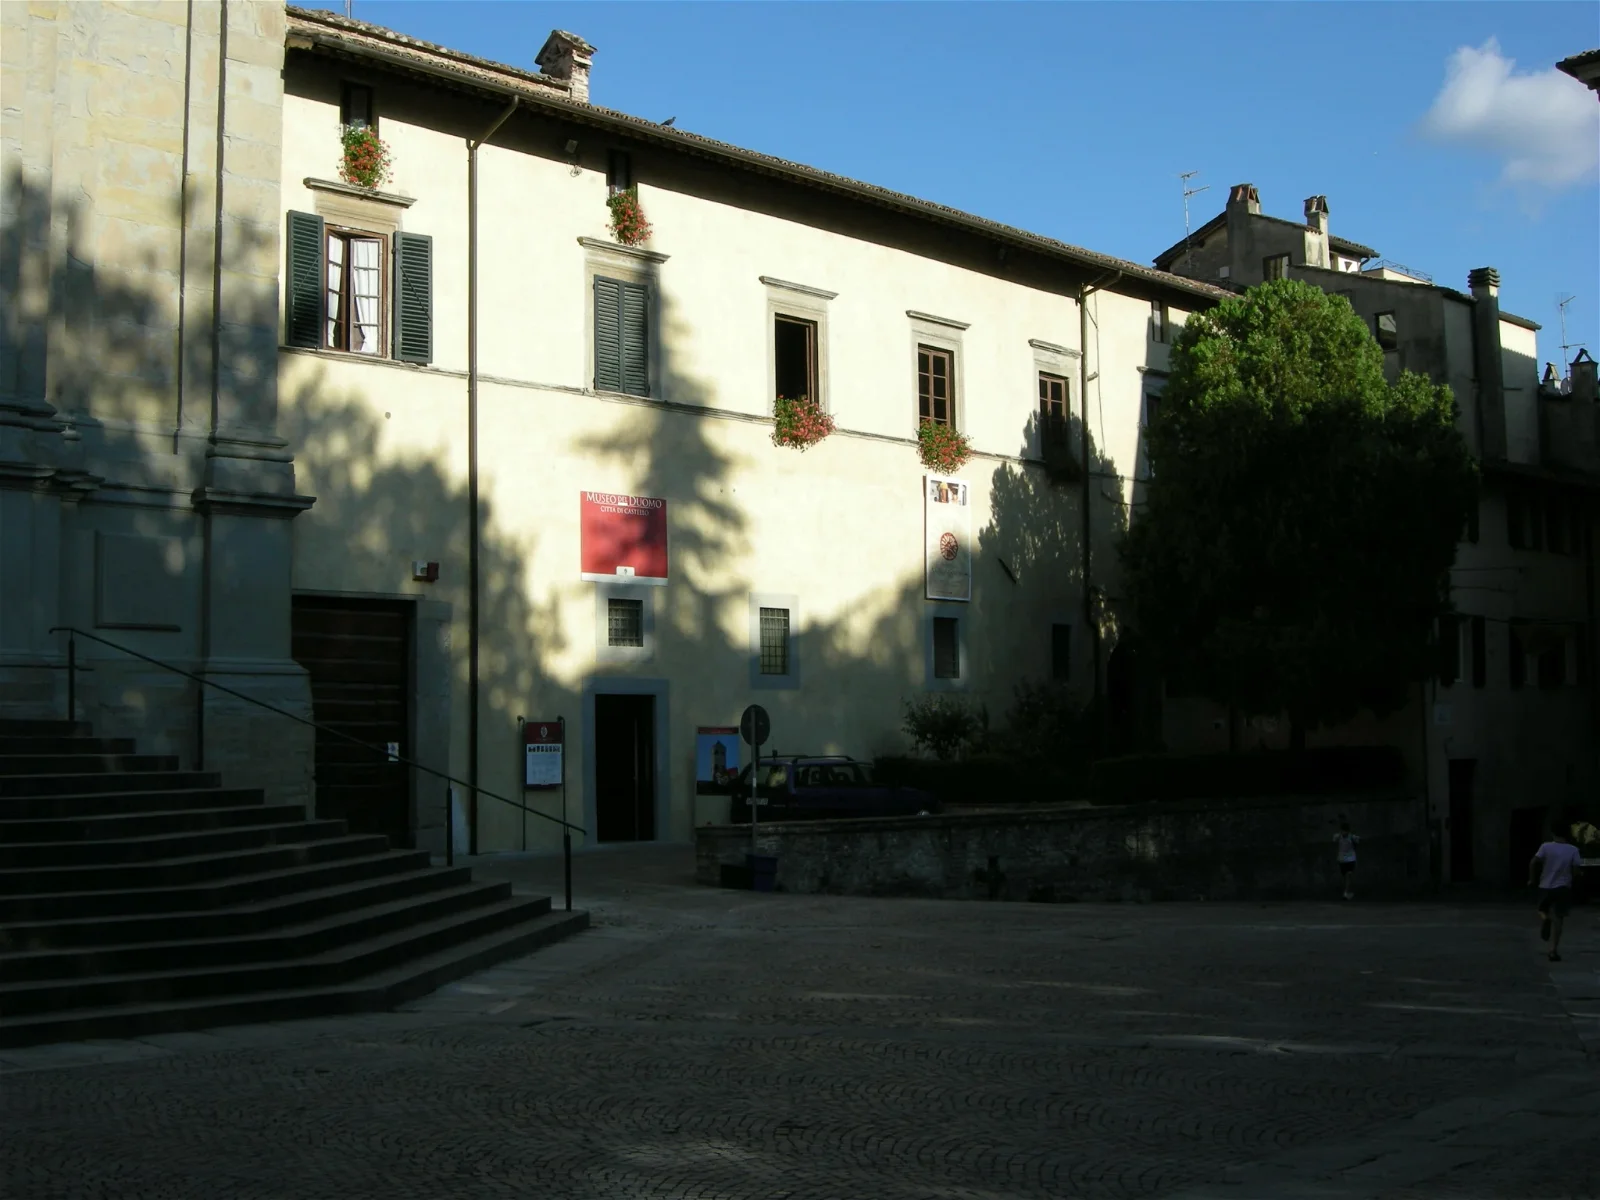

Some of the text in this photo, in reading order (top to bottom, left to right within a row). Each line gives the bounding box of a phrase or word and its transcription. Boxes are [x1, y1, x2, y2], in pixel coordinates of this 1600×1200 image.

[587, 492, 662, 508] MUSEO DEL DUOMO
[624, 508, 649, 516] CASTELLO
